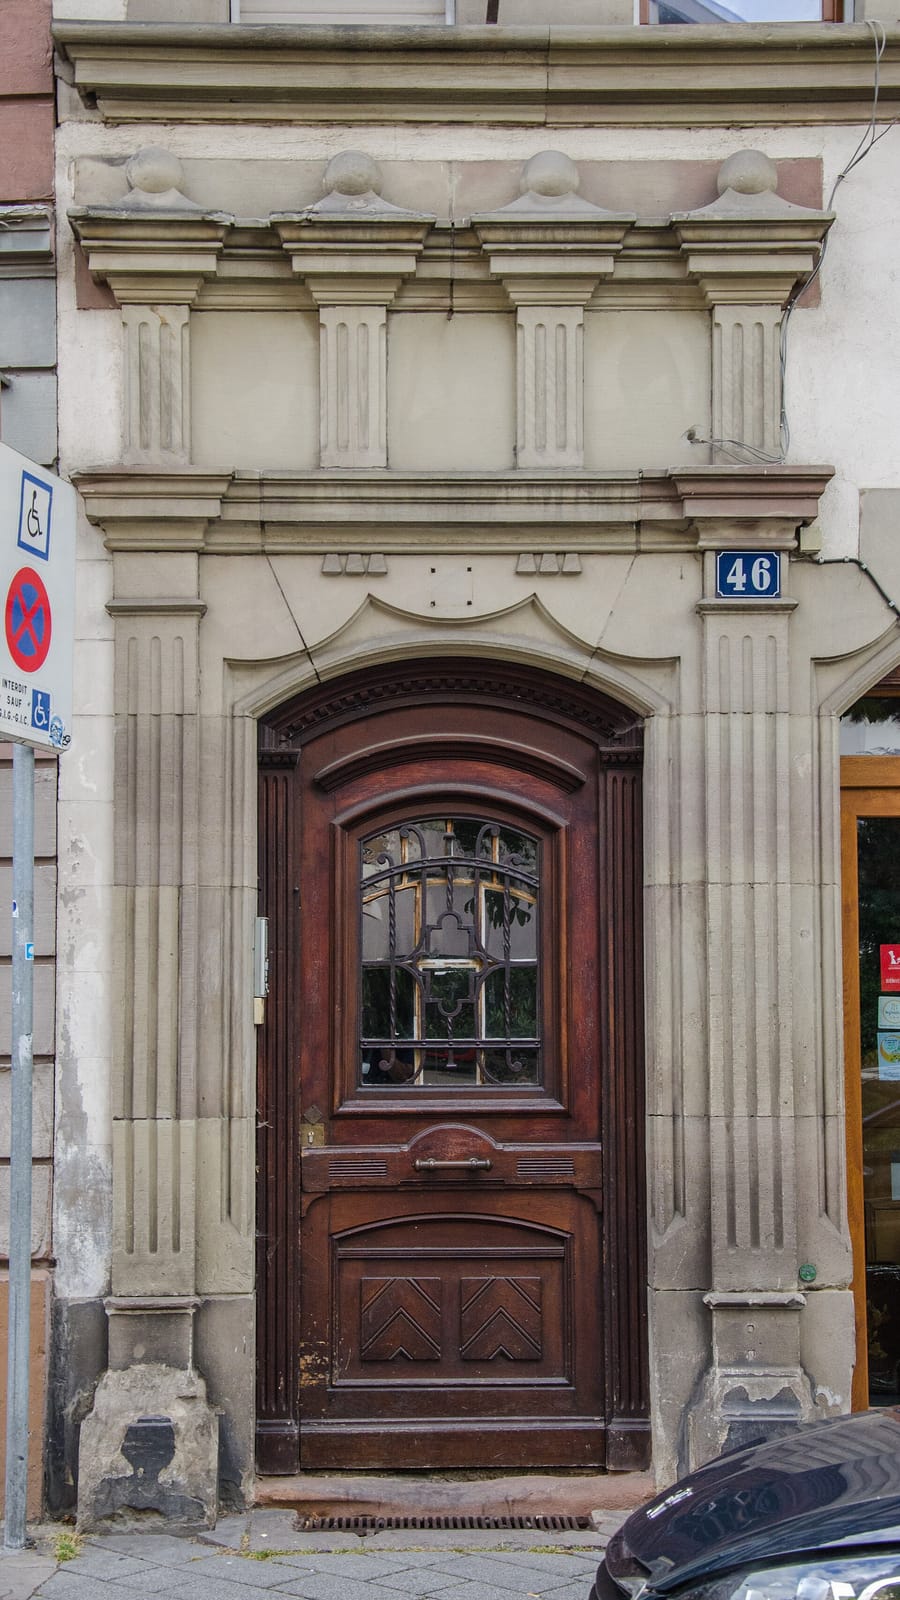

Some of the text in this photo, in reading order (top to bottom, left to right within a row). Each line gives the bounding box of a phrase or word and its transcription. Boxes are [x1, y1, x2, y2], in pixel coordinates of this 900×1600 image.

[727, 558, 771, 591] 46
[2, 679, 27, 695] INTERDIT
[7, 695, 22, 708] SAUF
